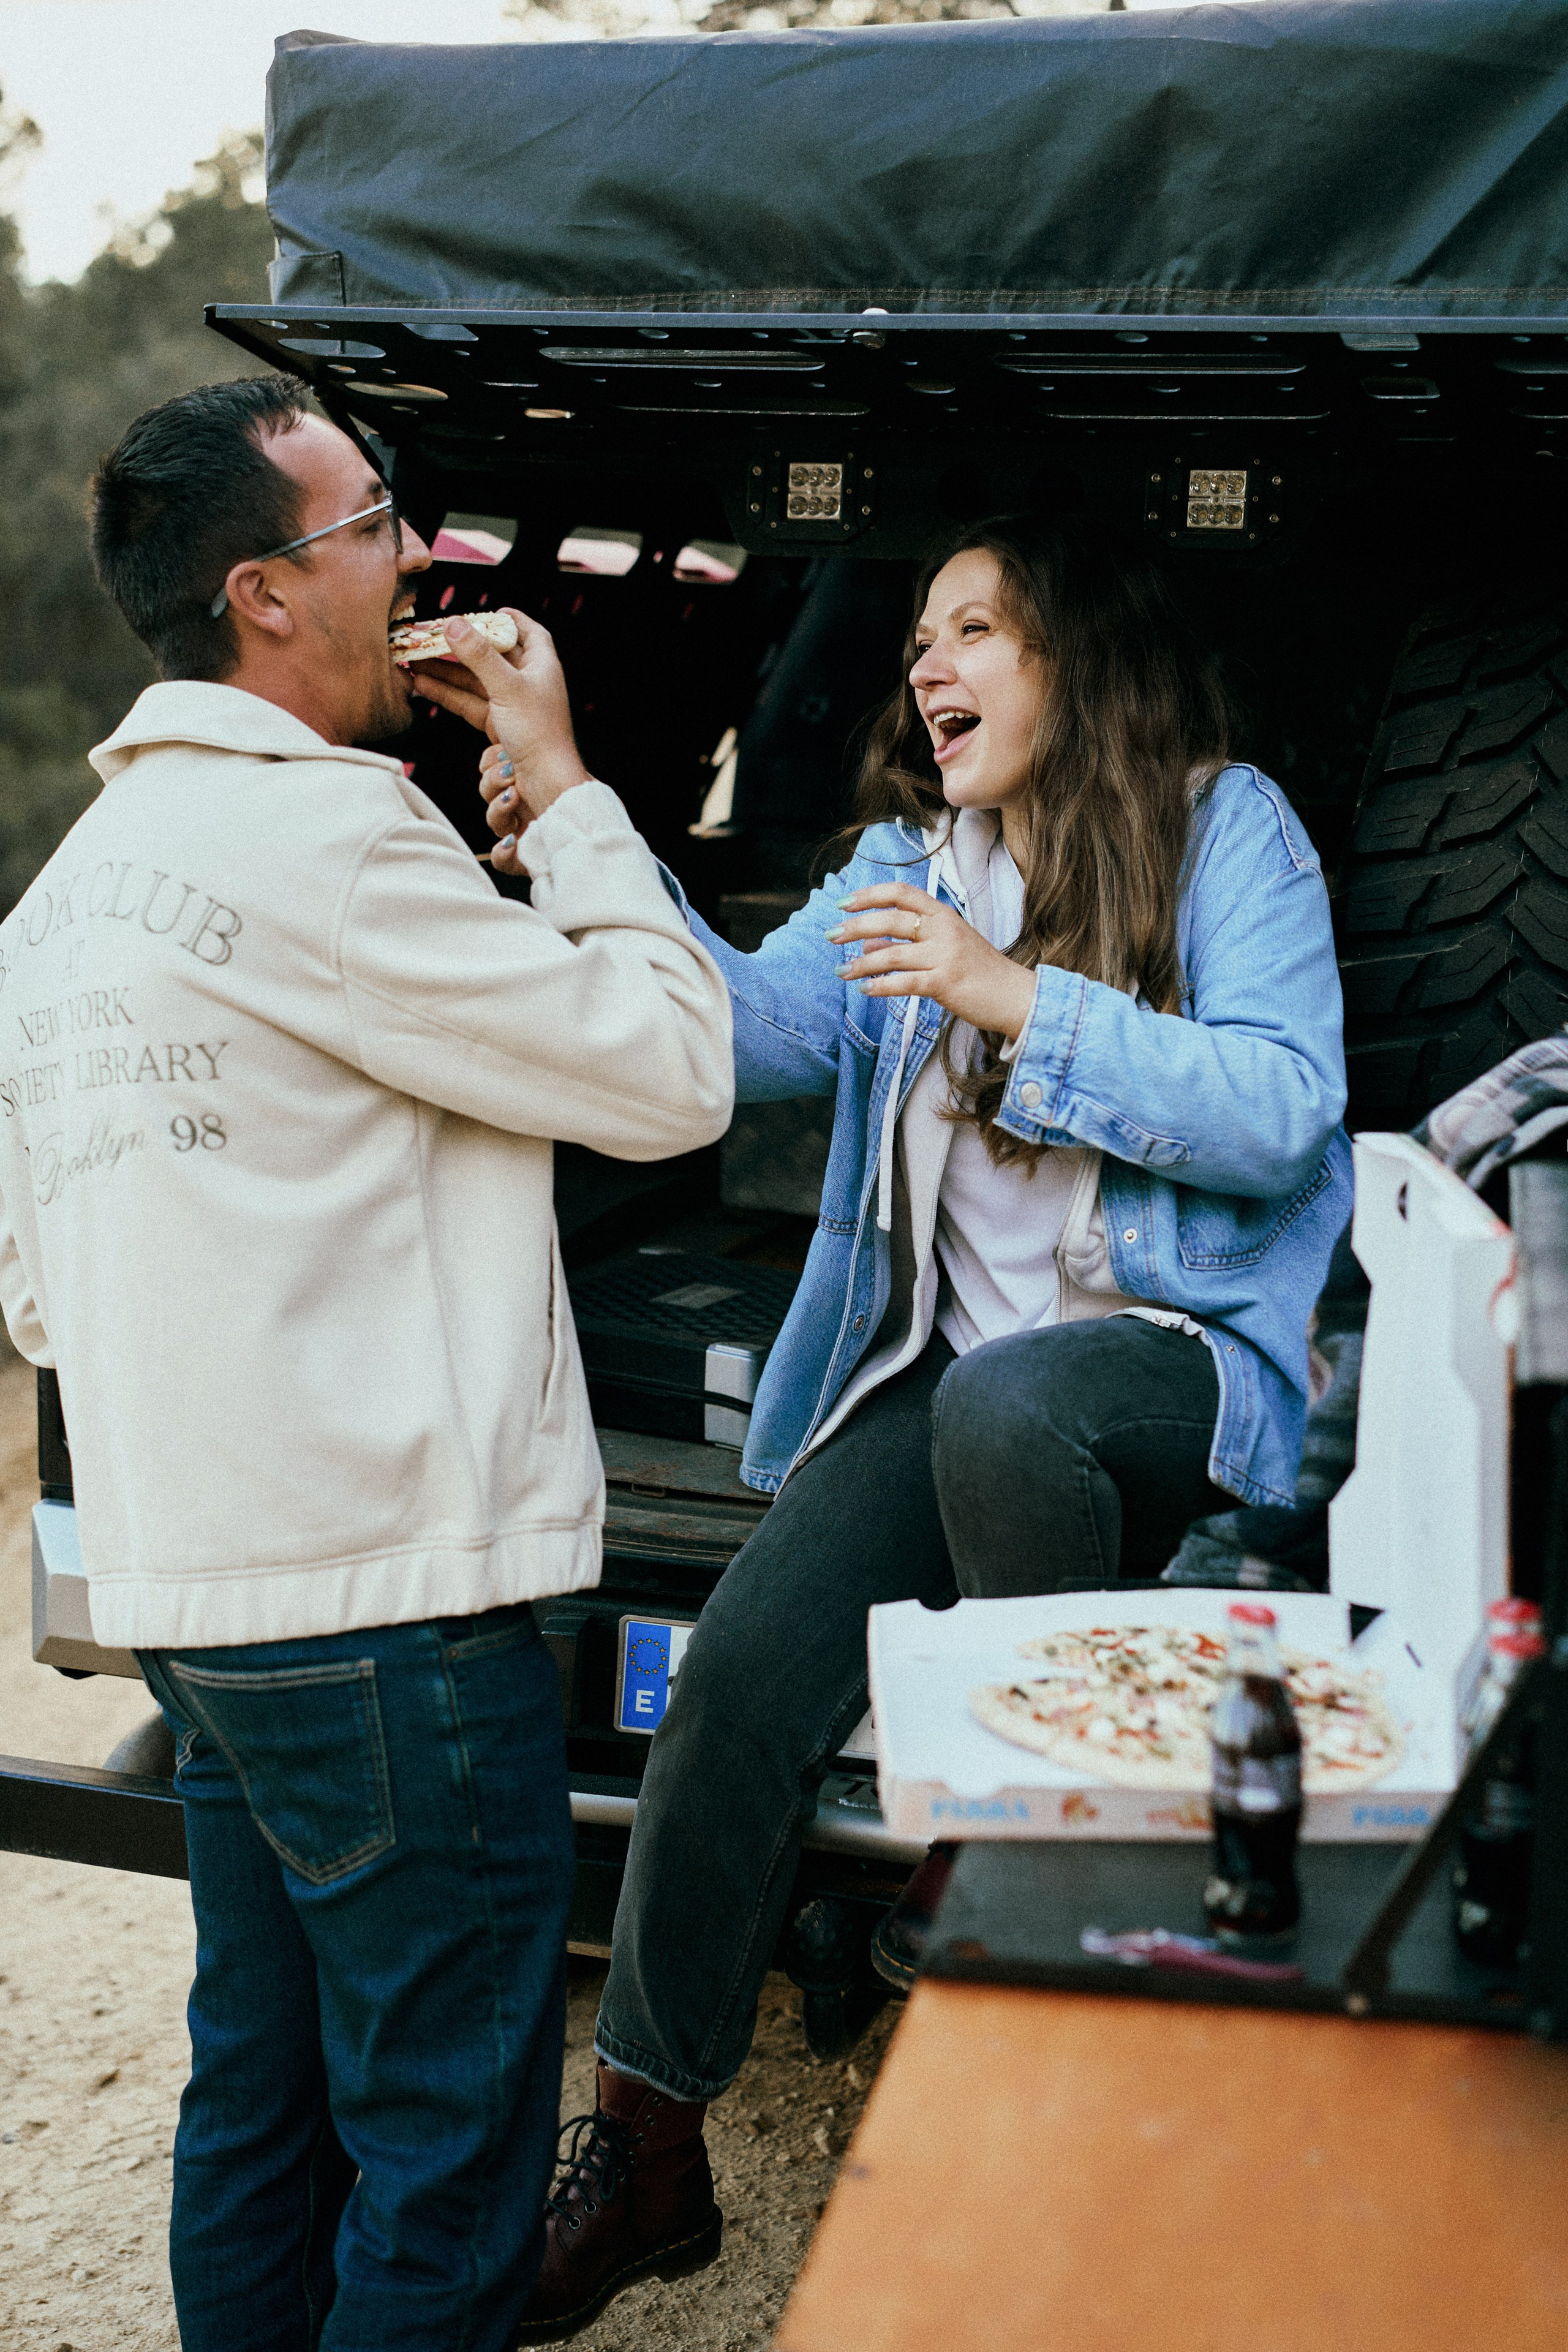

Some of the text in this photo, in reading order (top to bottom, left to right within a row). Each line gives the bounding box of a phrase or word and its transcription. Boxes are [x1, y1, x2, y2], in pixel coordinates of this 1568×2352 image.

[88, 861, 243, 966] CLUB
[67, 987, 134, 1035] YORK
[75, 1041, 230, 1093] LIBRARY
[170, 1114, 228, 1152] 98
[635, 1689, 655, 1714] E
